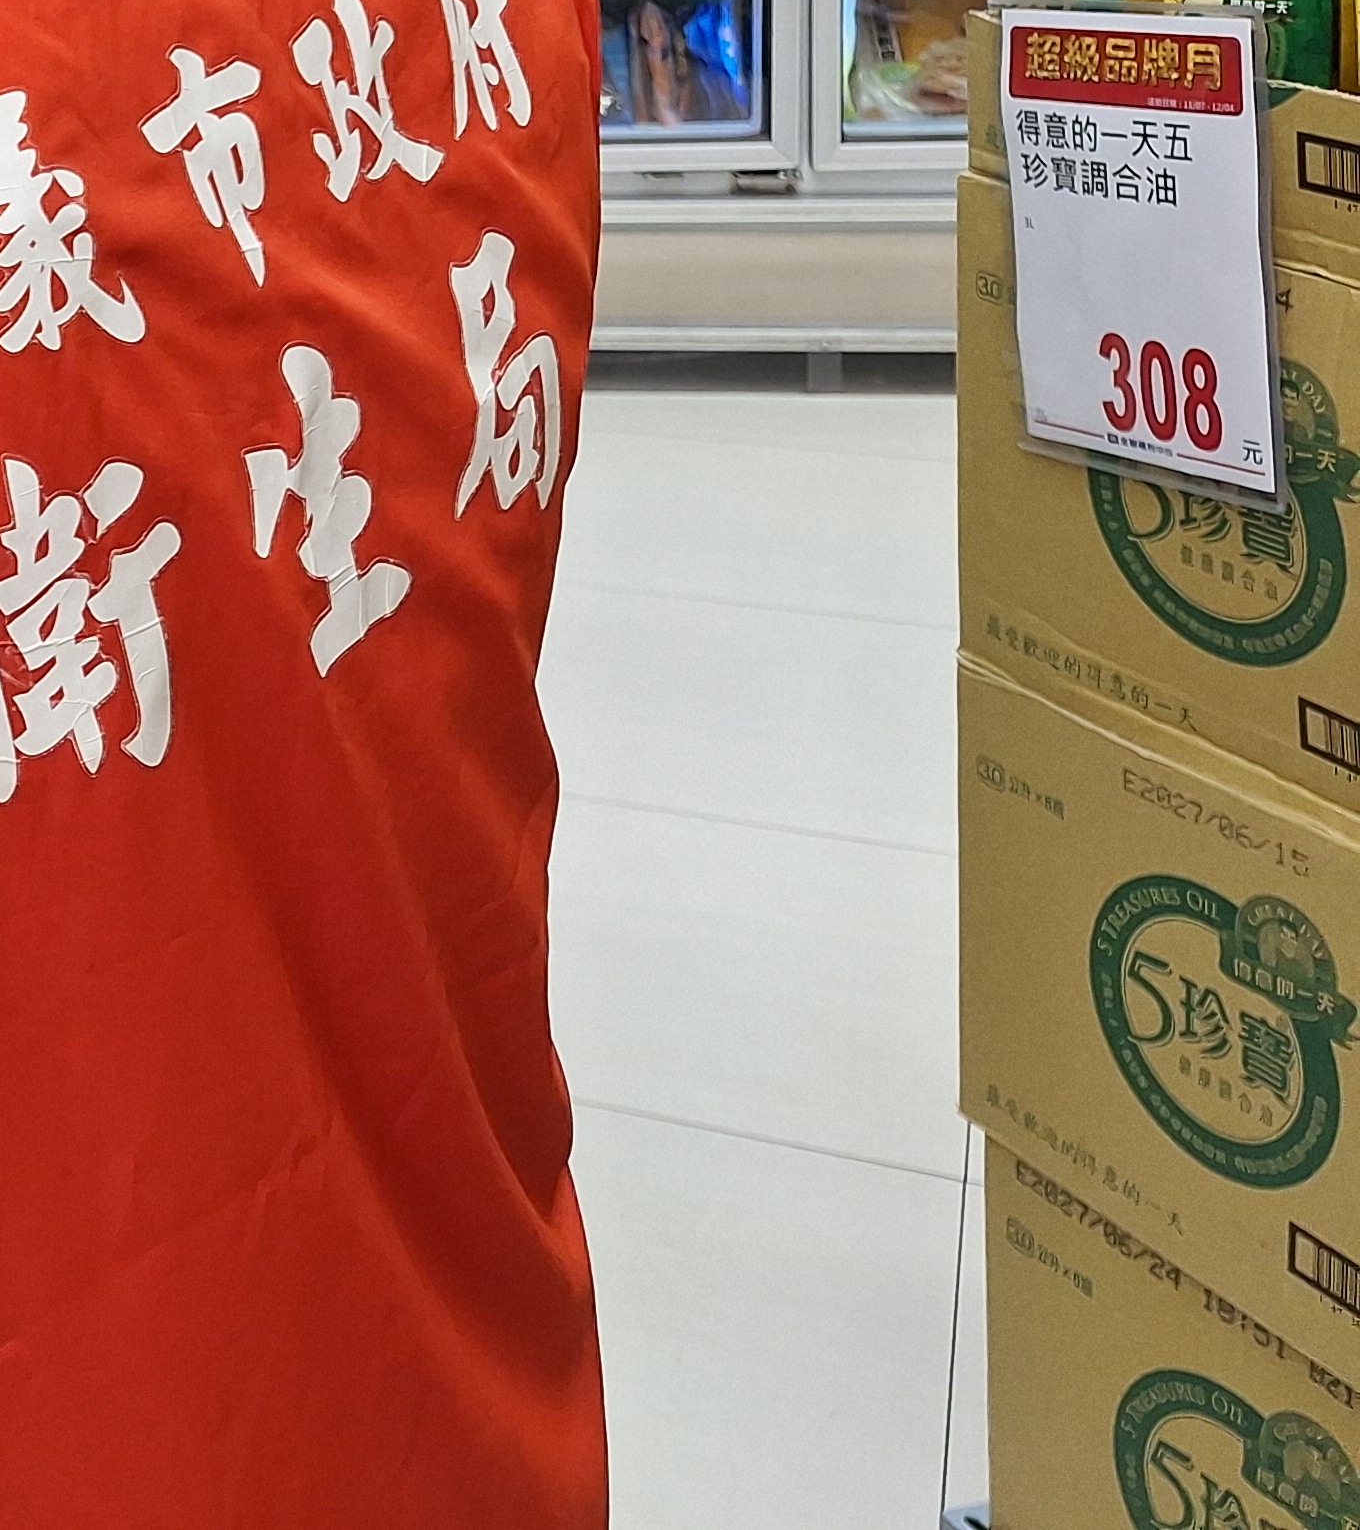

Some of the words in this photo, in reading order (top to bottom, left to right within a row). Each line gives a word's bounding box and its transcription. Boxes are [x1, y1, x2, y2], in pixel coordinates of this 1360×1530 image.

[1024, 31, 1223, 92] 超級品牌月
[1016, 109, 1193, 163] 得意的一天五
[1020, 152, 1178, 208] 珍寶調合油
[1098, 332, 1224, 453] 308
[1242, 439, 1264, 465] 元
[1122, 950, 1302, 1107] 5珍寶
